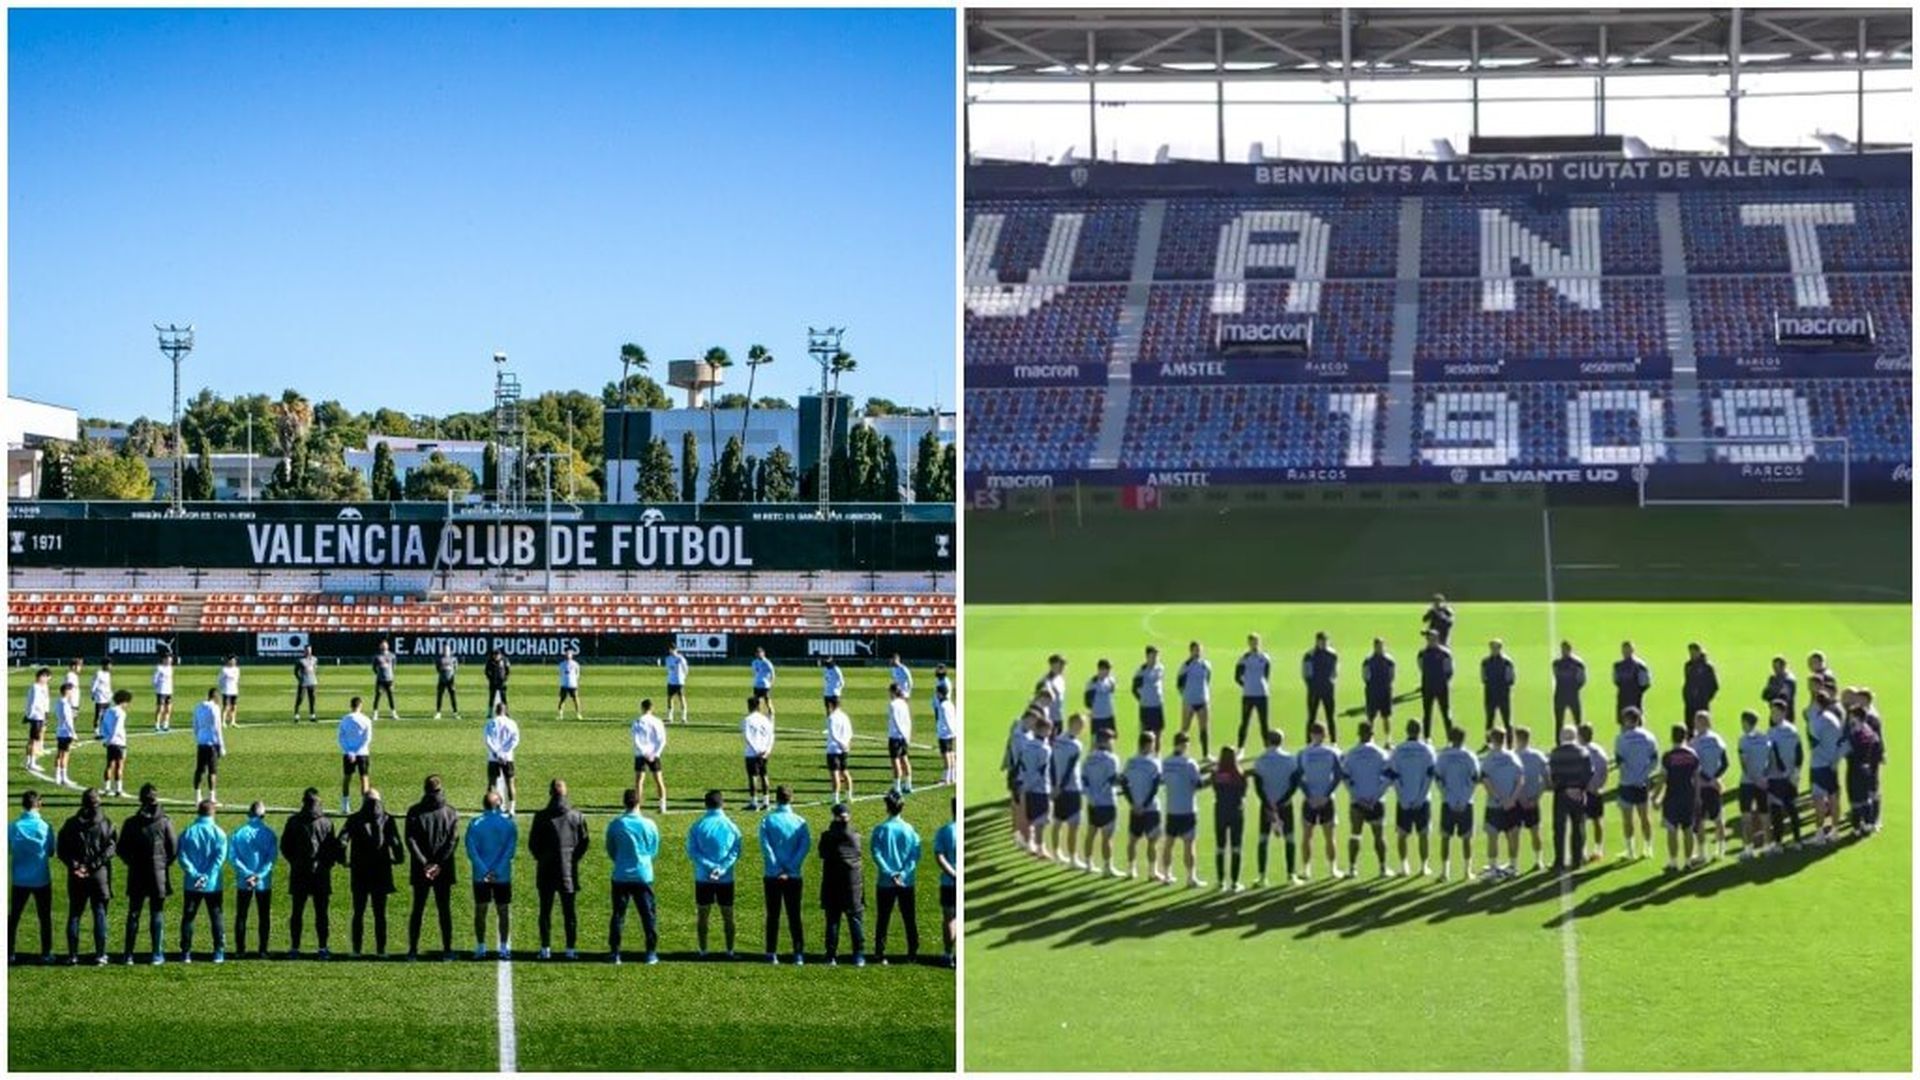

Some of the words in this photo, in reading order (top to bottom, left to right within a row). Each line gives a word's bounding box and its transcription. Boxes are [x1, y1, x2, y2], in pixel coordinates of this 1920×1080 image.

[1255, 165, 1413, 184] BENVINGUTS
[1421, 165, 1438, 181] A
[1446, 163, 1553, 182] L'ESTADI
[1563, 162, 1650, 180] CIUTAT
[1657, 161, 1691, 178] DE
[1699, 155, 1825, 177] VALÈNCIA
[1223, 321, 1308, 342] macron
[1779, 316, 1866, 336] macron
[1014, 364, 1079, 379] macron
[1160, 361, 1226, 377] AMSTEL
[987, 475, 1053, 489] macron
[1147, 472, 1210, 487] AMSTEL
[1480, 470, 1580, 482] LEVANTE
[1586, 469, 1619, 482] UD
[32, 534, 62, 551] 1971
[247, 524, 426, 564] VALENCIA
[440, 524, 535, 565] CLUB
[551, 525, 597, 565] DE
[611, 518, 753, 567] FÚTBOL
[108, 637, 157, 654] PUMA
[260, 637, 278, 647] TM
[395, 637, 409, 655] E.
[414, 637, 488, 655] ANTONIO
[493, 637, 581, 655] PUCHADES
[680, 638, 697, 648] TM
[808, 639, 857, 655] PUMA
